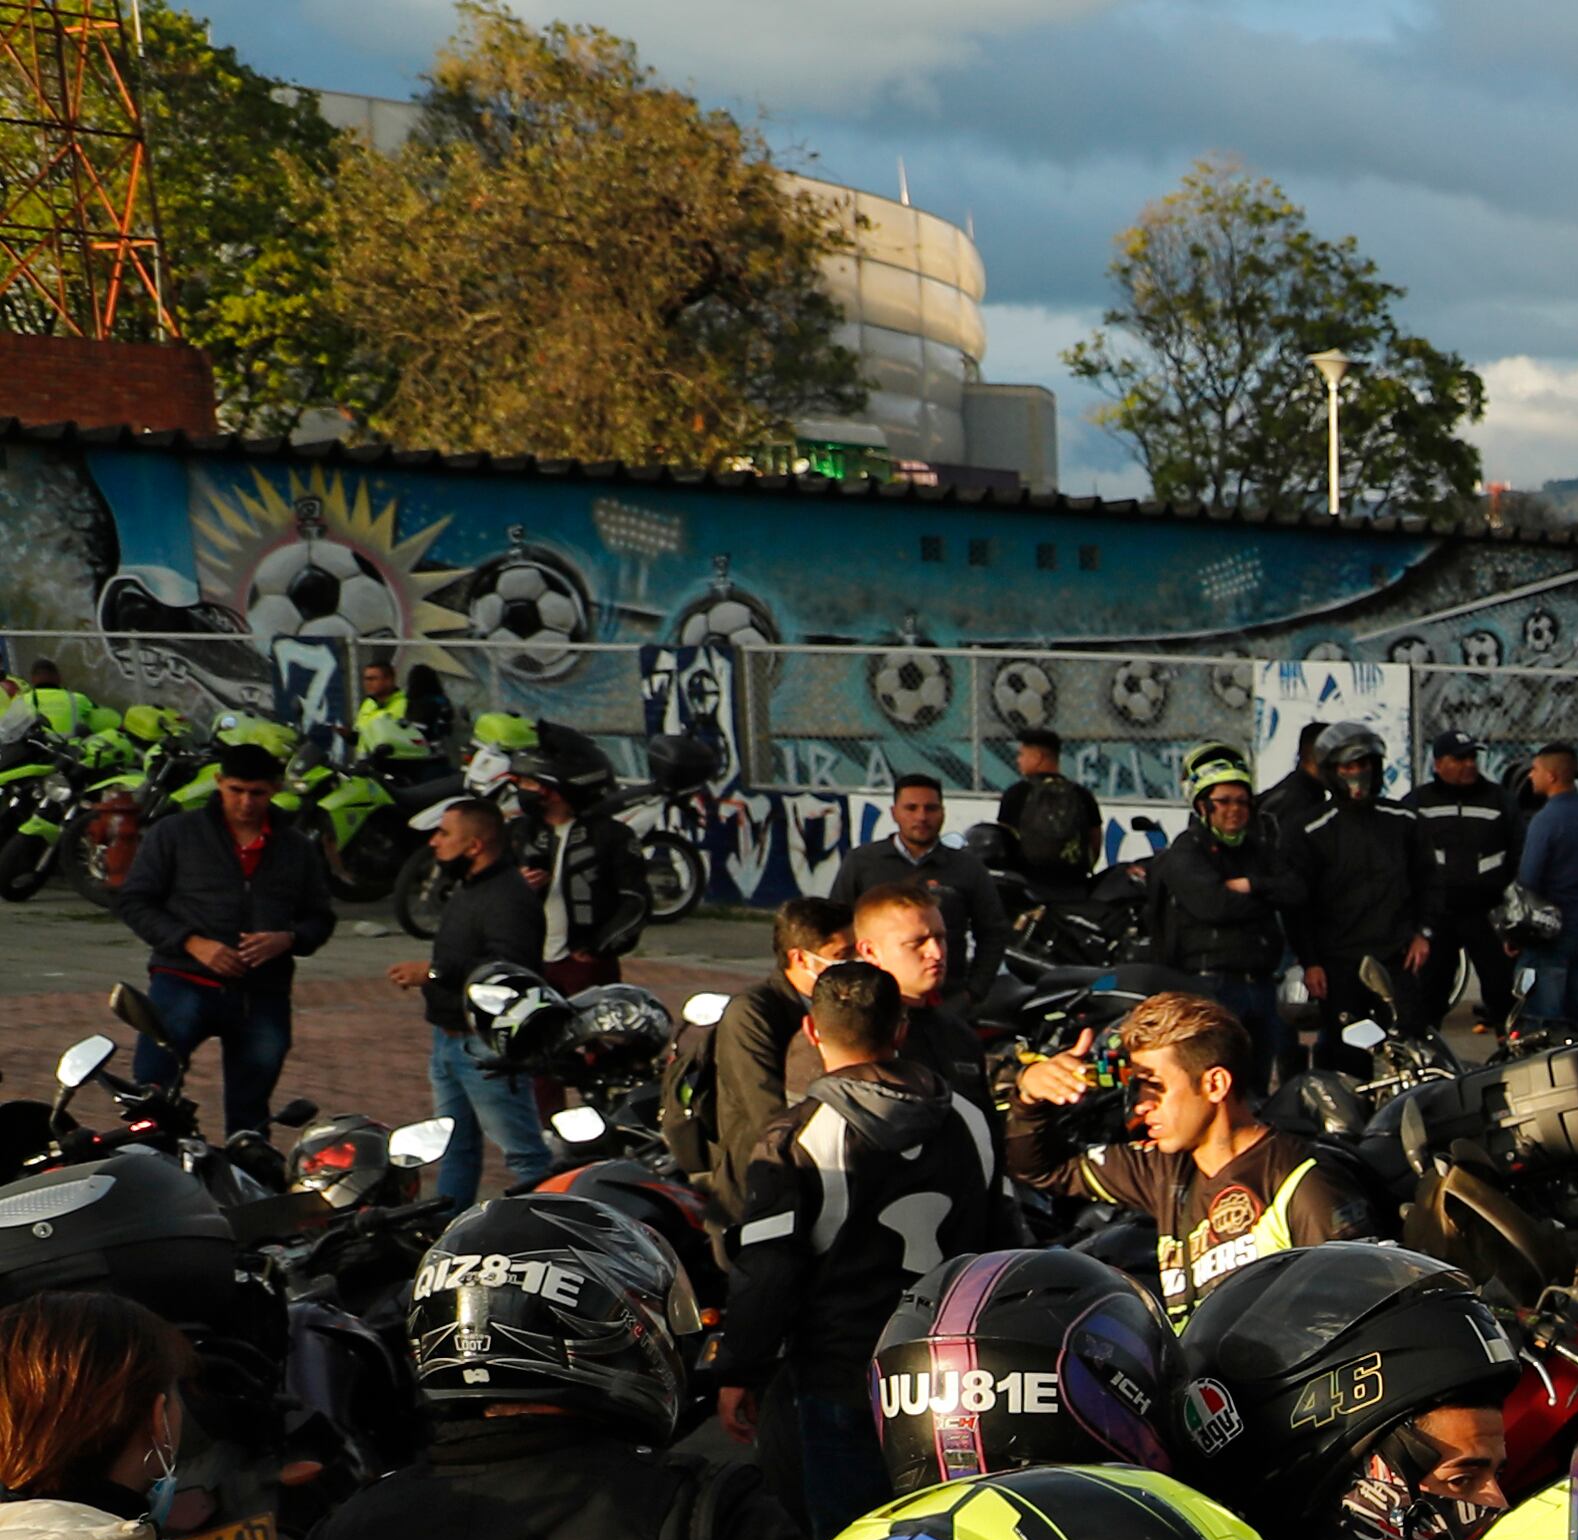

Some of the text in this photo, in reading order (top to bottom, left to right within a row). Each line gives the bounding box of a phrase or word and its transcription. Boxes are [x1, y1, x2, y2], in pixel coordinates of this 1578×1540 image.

[880, 1369, 1060, 1418] UUJ81E
[1109, 1369, 1153, 1416] ICH
[1290, 1351, 1384, 1429] 46
